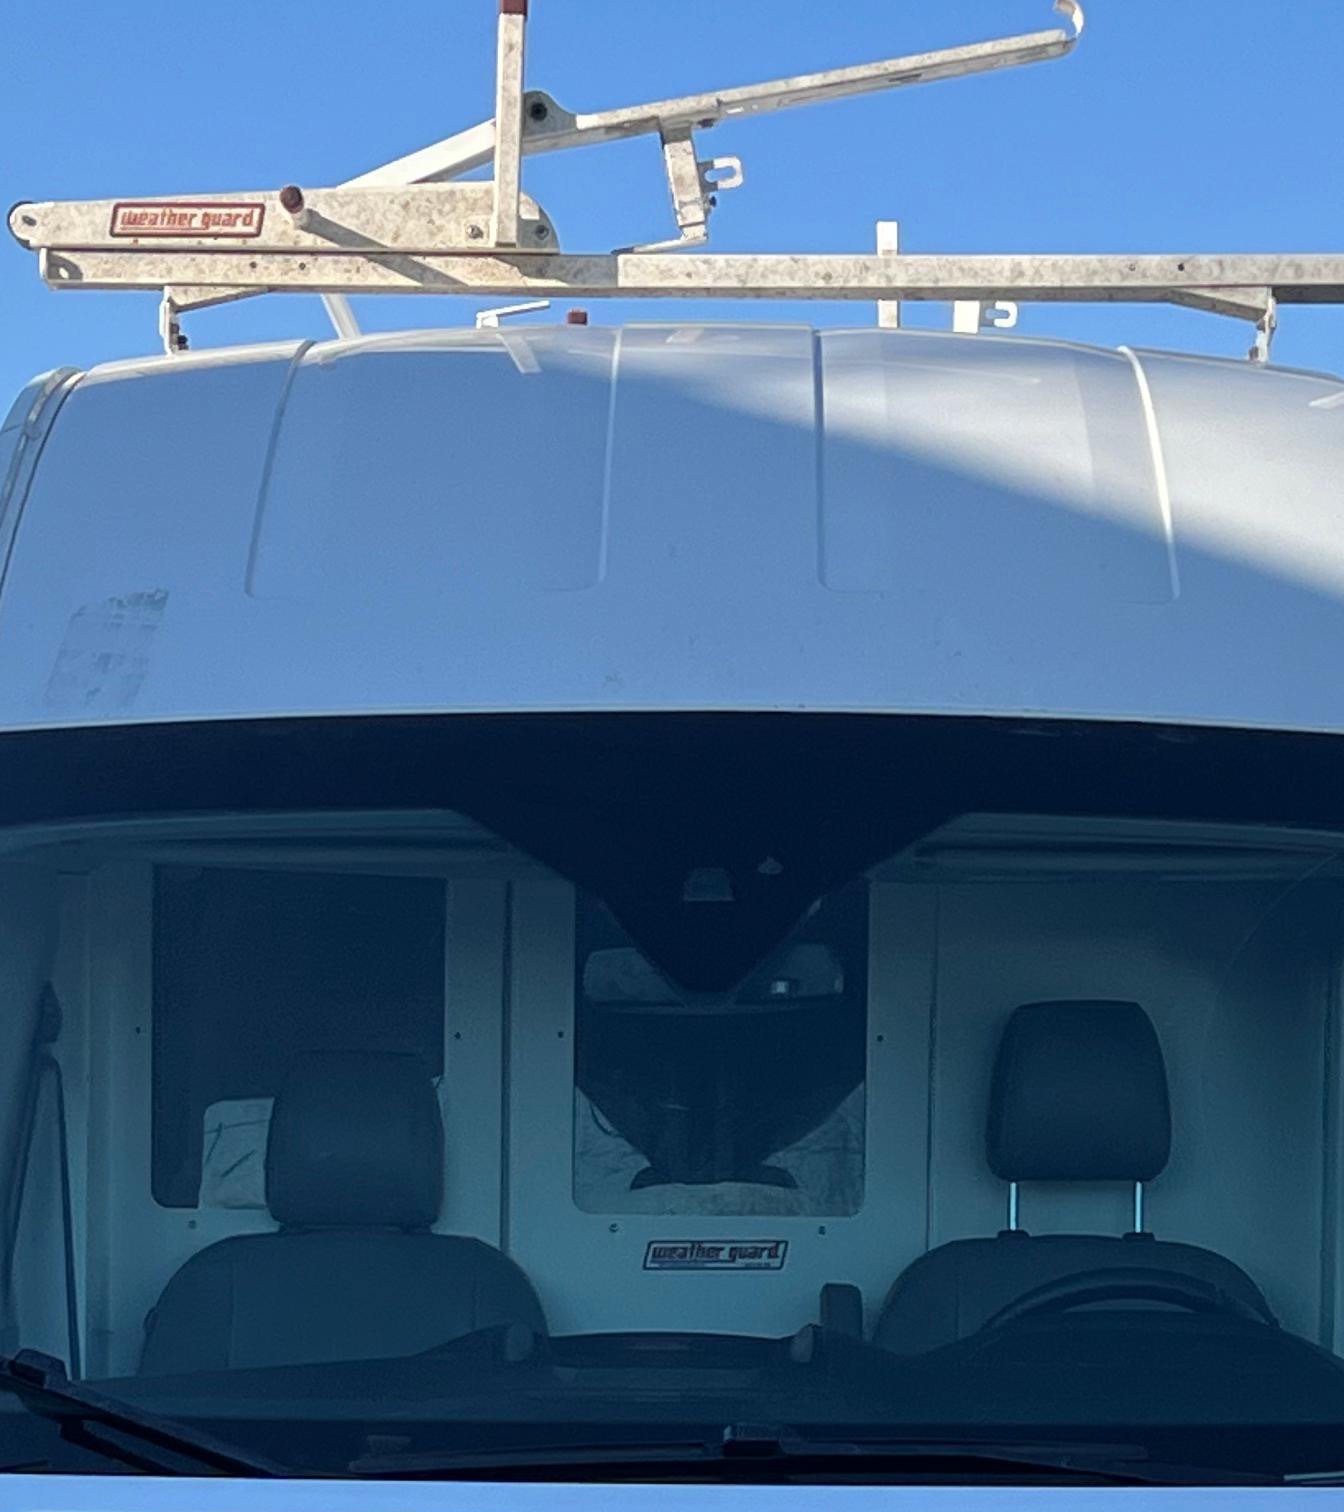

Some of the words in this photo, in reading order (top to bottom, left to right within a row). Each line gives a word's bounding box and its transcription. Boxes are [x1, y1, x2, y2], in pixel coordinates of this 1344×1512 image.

[120, 208, 198, 228] weather
[201, 208, 255, 231] guard
[729, 1240, 780, 1263] guard
